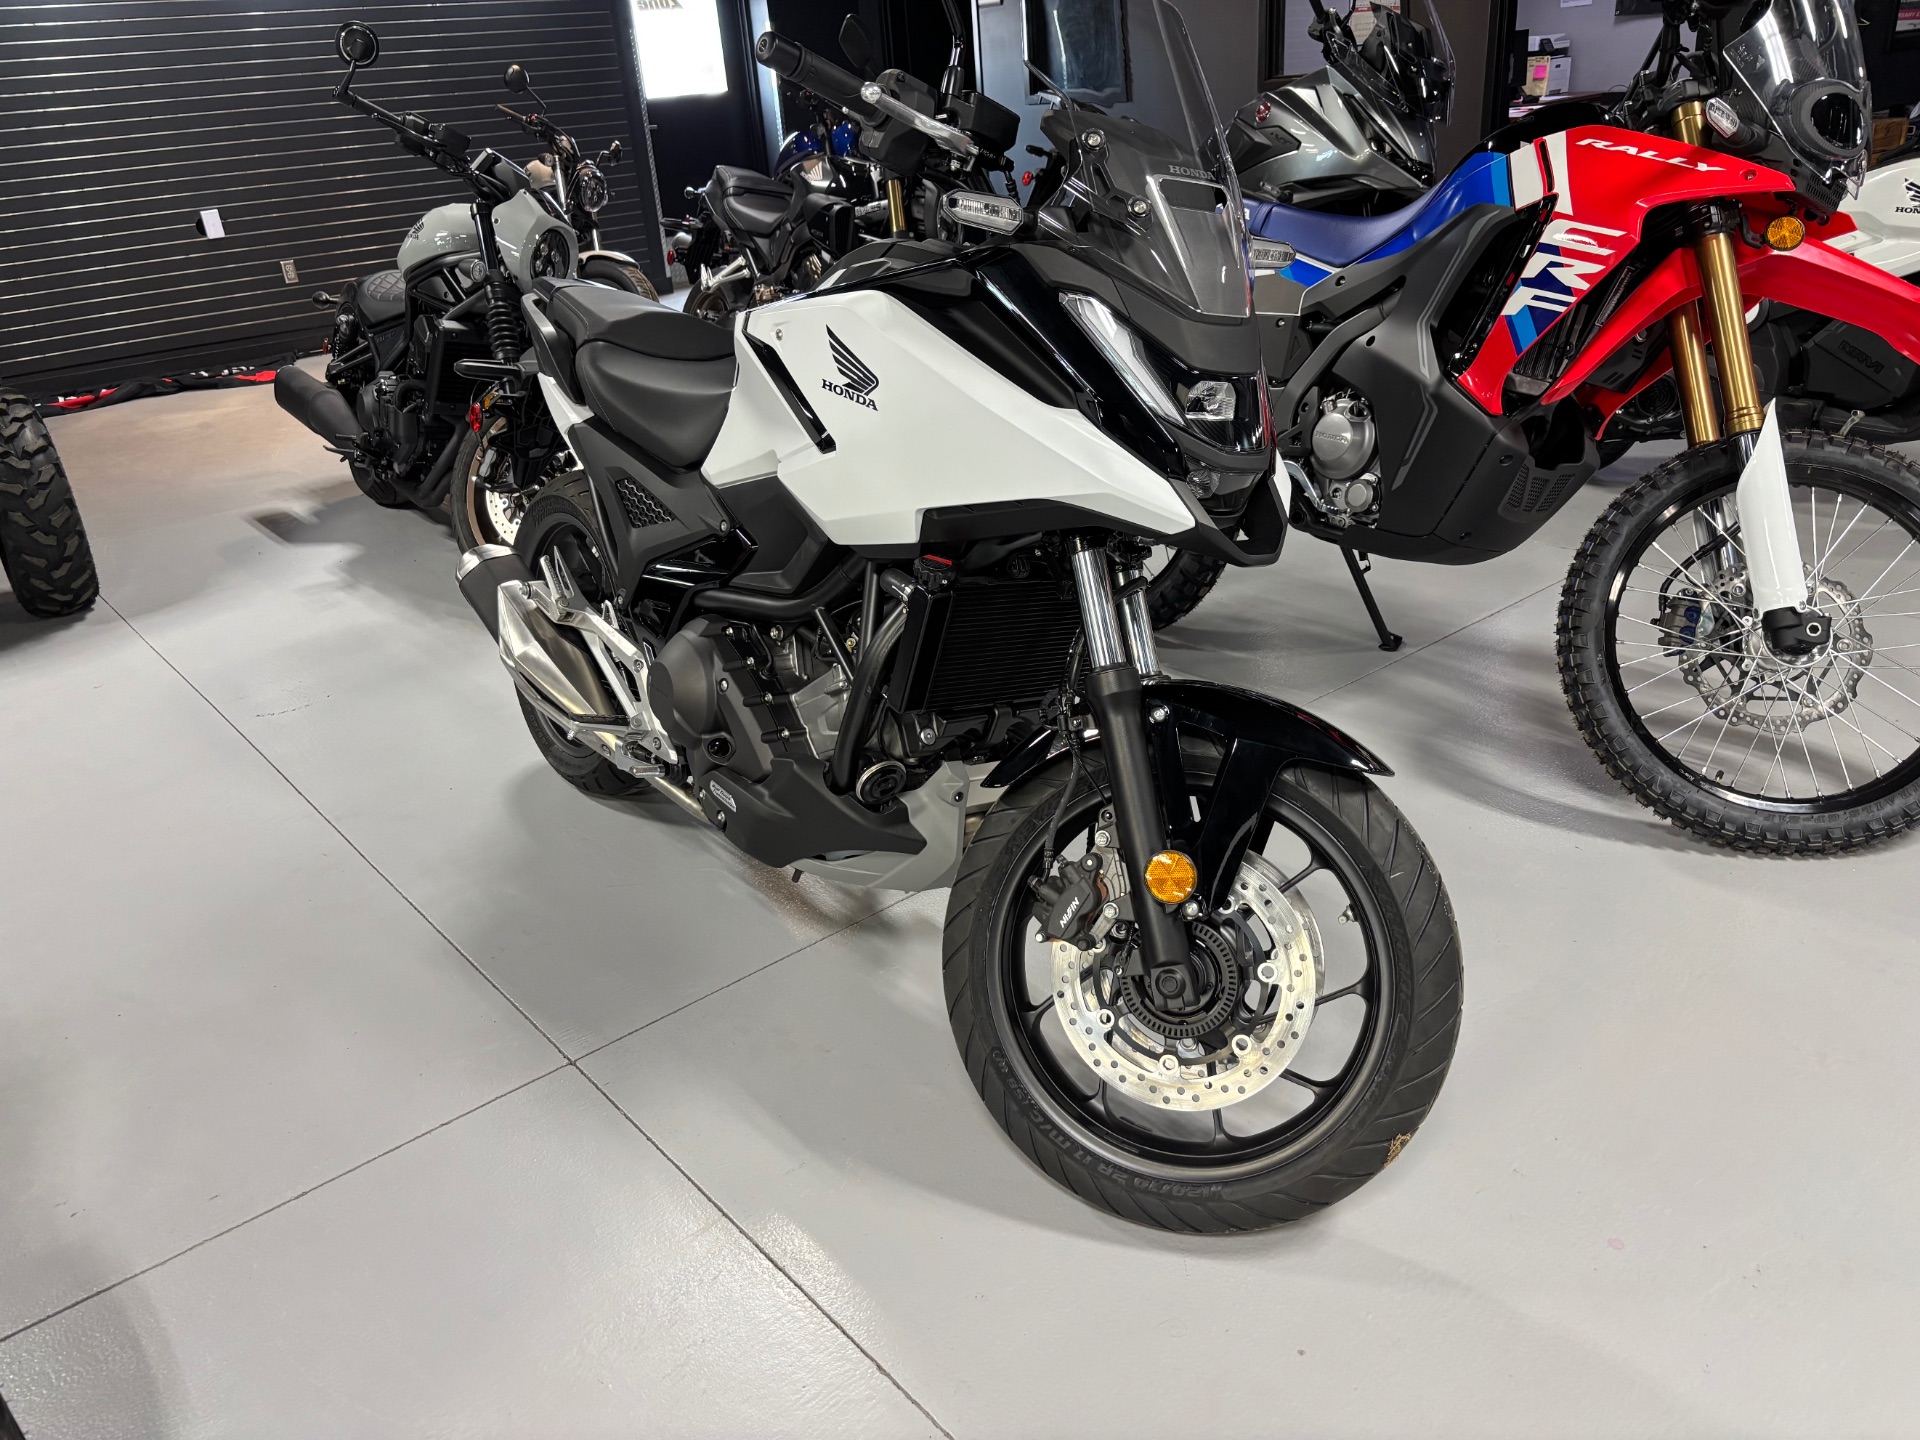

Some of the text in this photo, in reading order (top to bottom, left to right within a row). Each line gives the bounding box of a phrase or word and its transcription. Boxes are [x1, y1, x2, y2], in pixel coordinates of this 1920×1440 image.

[1576, 138, 1727, 172] RALLY
[1168, 164, 1216, 181] HONDA
[1500, 219, 1628, 316] CRF
[821, 378, 879, 411] HONDA
[1060, 896, 1080, 929] NISSIN
